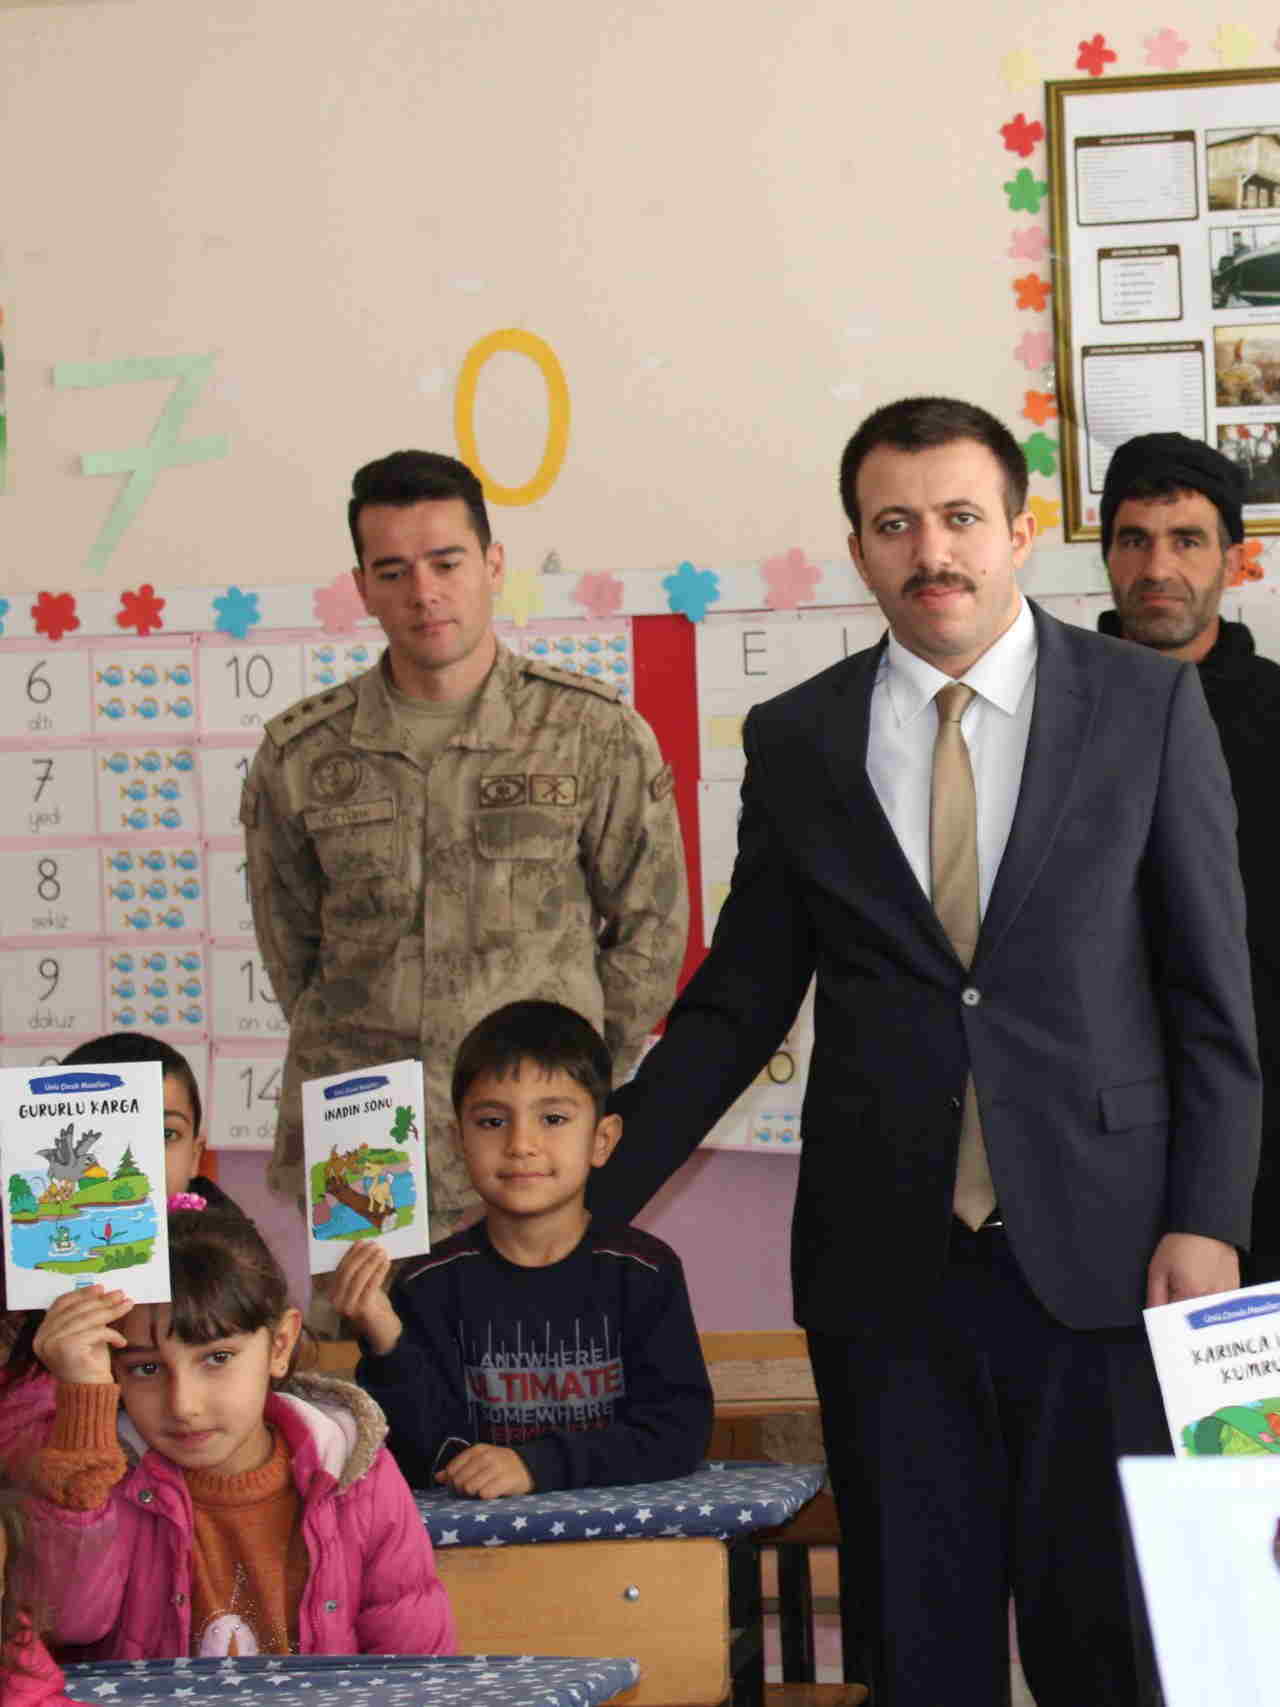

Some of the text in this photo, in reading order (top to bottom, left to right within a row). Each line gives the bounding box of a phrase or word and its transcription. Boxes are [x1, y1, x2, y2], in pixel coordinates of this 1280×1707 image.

[226, 653, 273, 698] 10
[742, 631, 768, 675] E
[26, 659, 52, 704] 6
[31, 757, 54, 803] 7
[37, 857, 61, 902] 8
[38, 957, 60, 1002] 9
[18, 1098, 140, 1119] GURURLU KARGA
[480, 1347, 605, 1369] ANYWHERE
[1192, 1334, 1269, 1365] KARINCA
